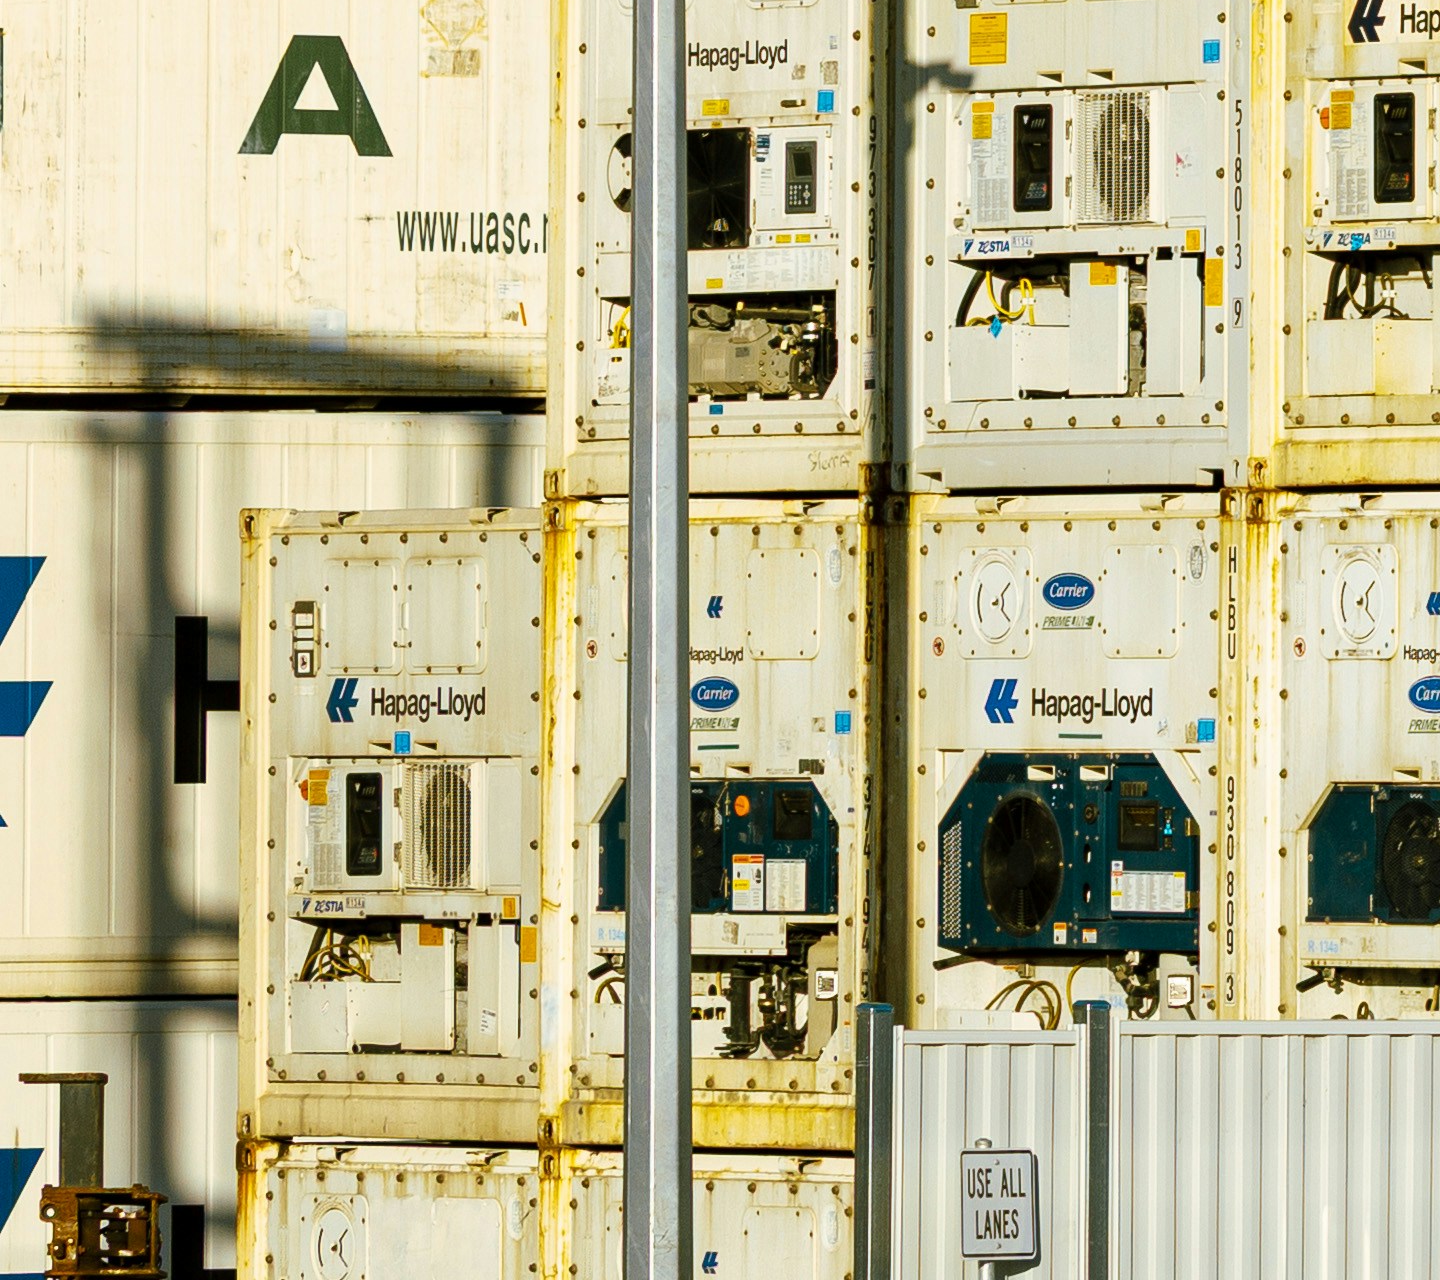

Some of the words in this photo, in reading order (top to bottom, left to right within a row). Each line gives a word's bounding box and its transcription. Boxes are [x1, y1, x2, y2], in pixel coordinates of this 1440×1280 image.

[687, 38, 788, 72] Hapag-Lloyd
[1233, 100, 1244, 271] 518013
[1233, 299, 1243, 327] 9
[1050, 583, 1089, 598] Carrier
[1227, 548, 1237, 661] HLBU
[371, 687, 486, 723] Hapag-Lloyd
[697, 686, 734, 701] Carrier
[1031, 687, 1153, 724] Hapag-Lloyd
[1226, 776, 1235, 861] 930
[1225, 870, 1235, 956] 809
[1225, 974, 1235, 1003] 3
[967, 1168, 993, 1199] USE
[1000, 1167, 1026, 1198] ALL
[975, 1208, 1019, 1240] LANES
